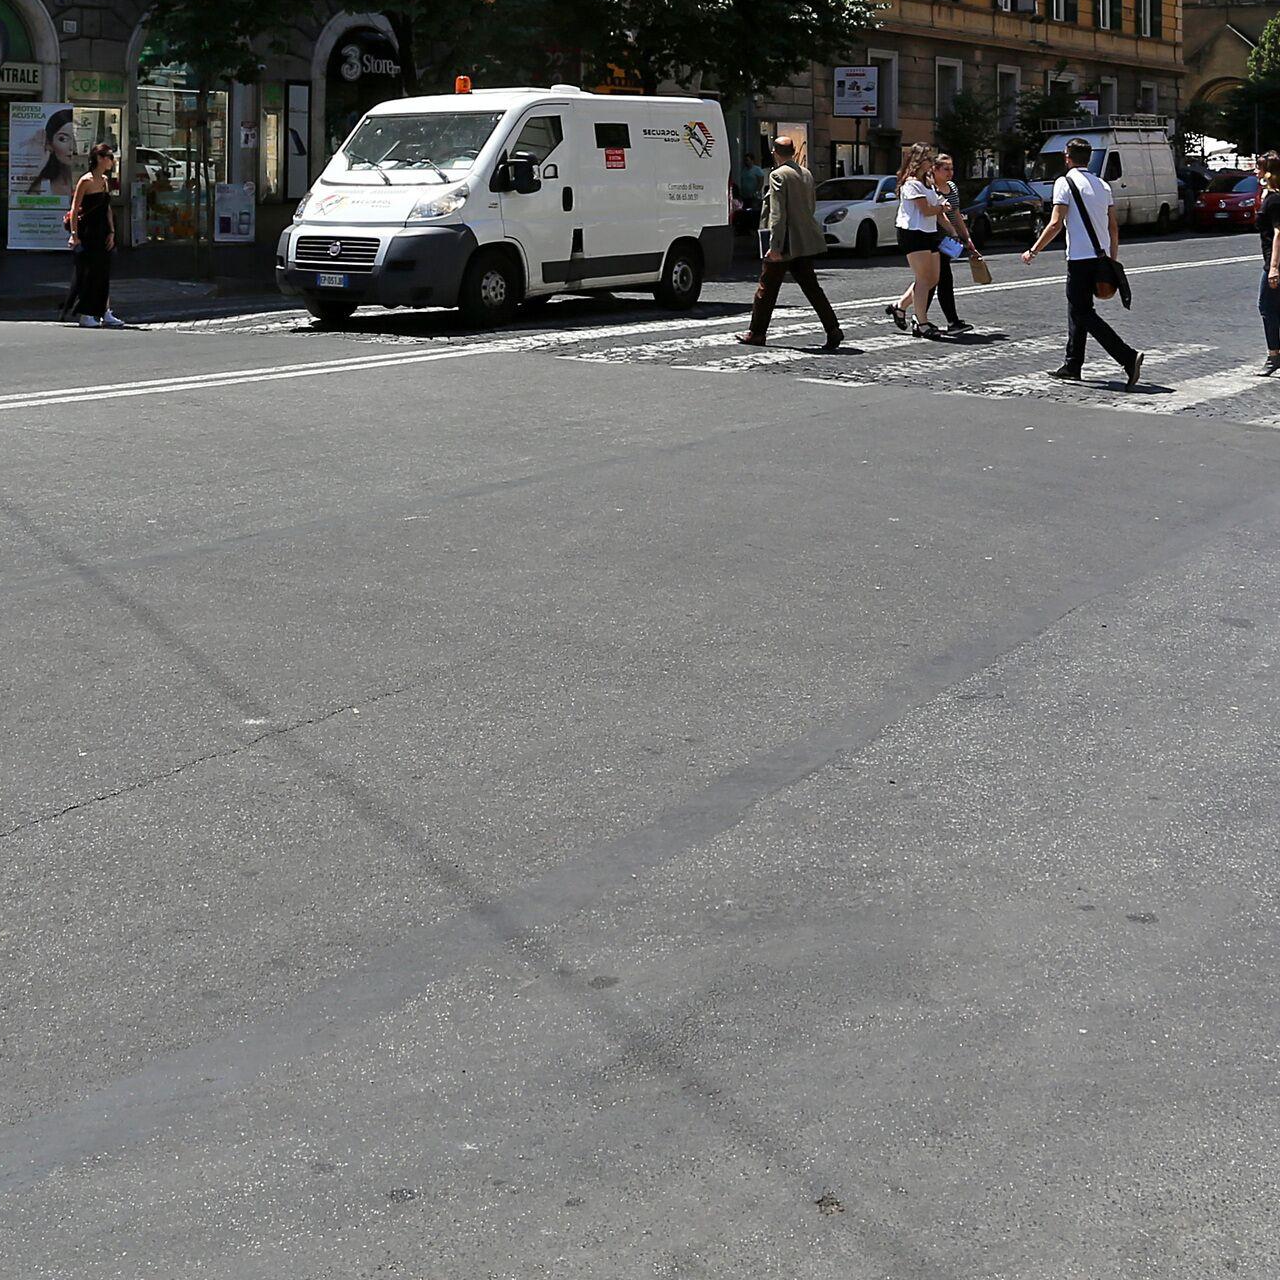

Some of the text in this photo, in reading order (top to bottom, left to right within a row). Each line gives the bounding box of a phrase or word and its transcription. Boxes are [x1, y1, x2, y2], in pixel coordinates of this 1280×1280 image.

[340, 44, 363, 82] 3
[362, 54, 394, 74] Store
[71, 78, 124, 94] COSMESI
[642, 129, 680, 137] SECURPOL
